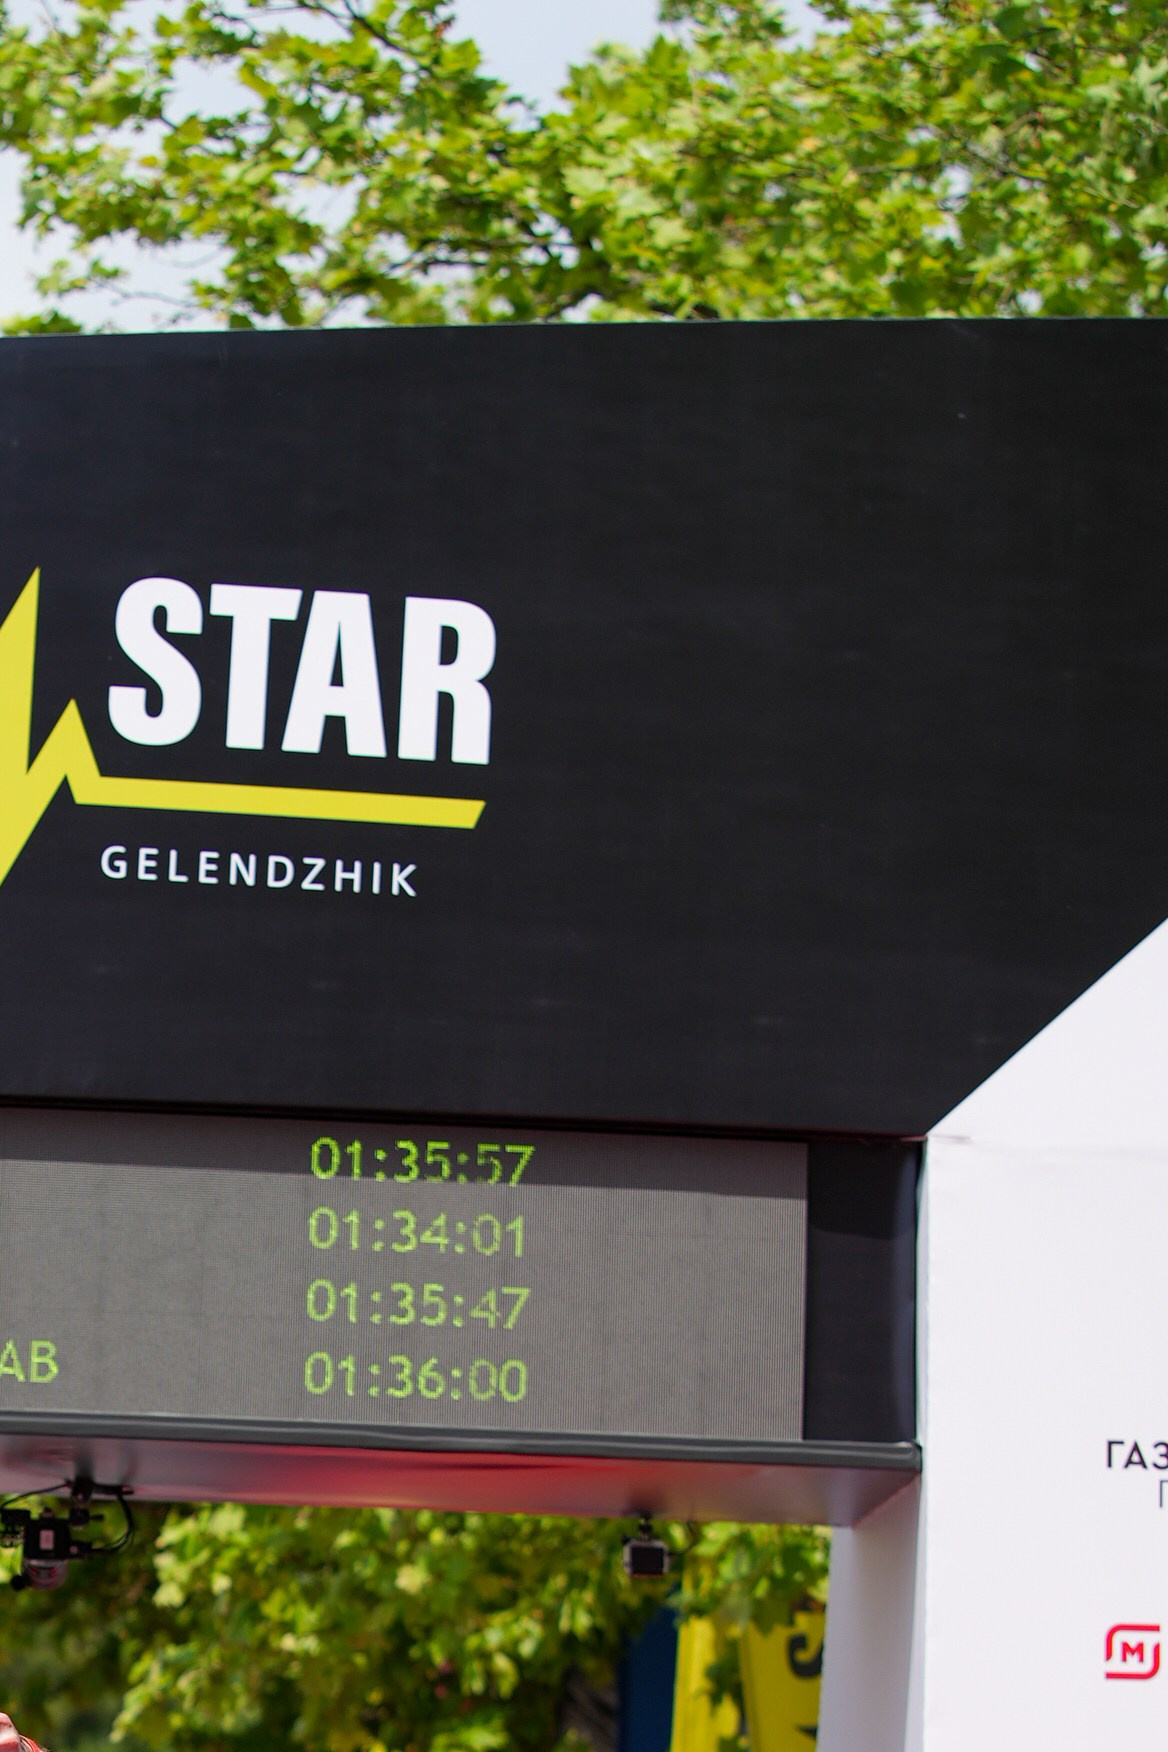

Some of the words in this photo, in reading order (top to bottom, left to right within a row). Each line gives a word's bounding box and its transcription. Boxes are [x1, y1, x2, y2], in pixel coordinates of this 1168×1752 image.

[108, 577, 496, 765] STAR
[101, 845, 416, 897] GELENDZHIK
[309, 1136, 536, 1188] 01:35:57
[306, 1207, 528, 1259] 01:34:01
[304, 1279, 531, 1332] 01:35:47
[301, 1352, 530, 1403] 01:36:00
